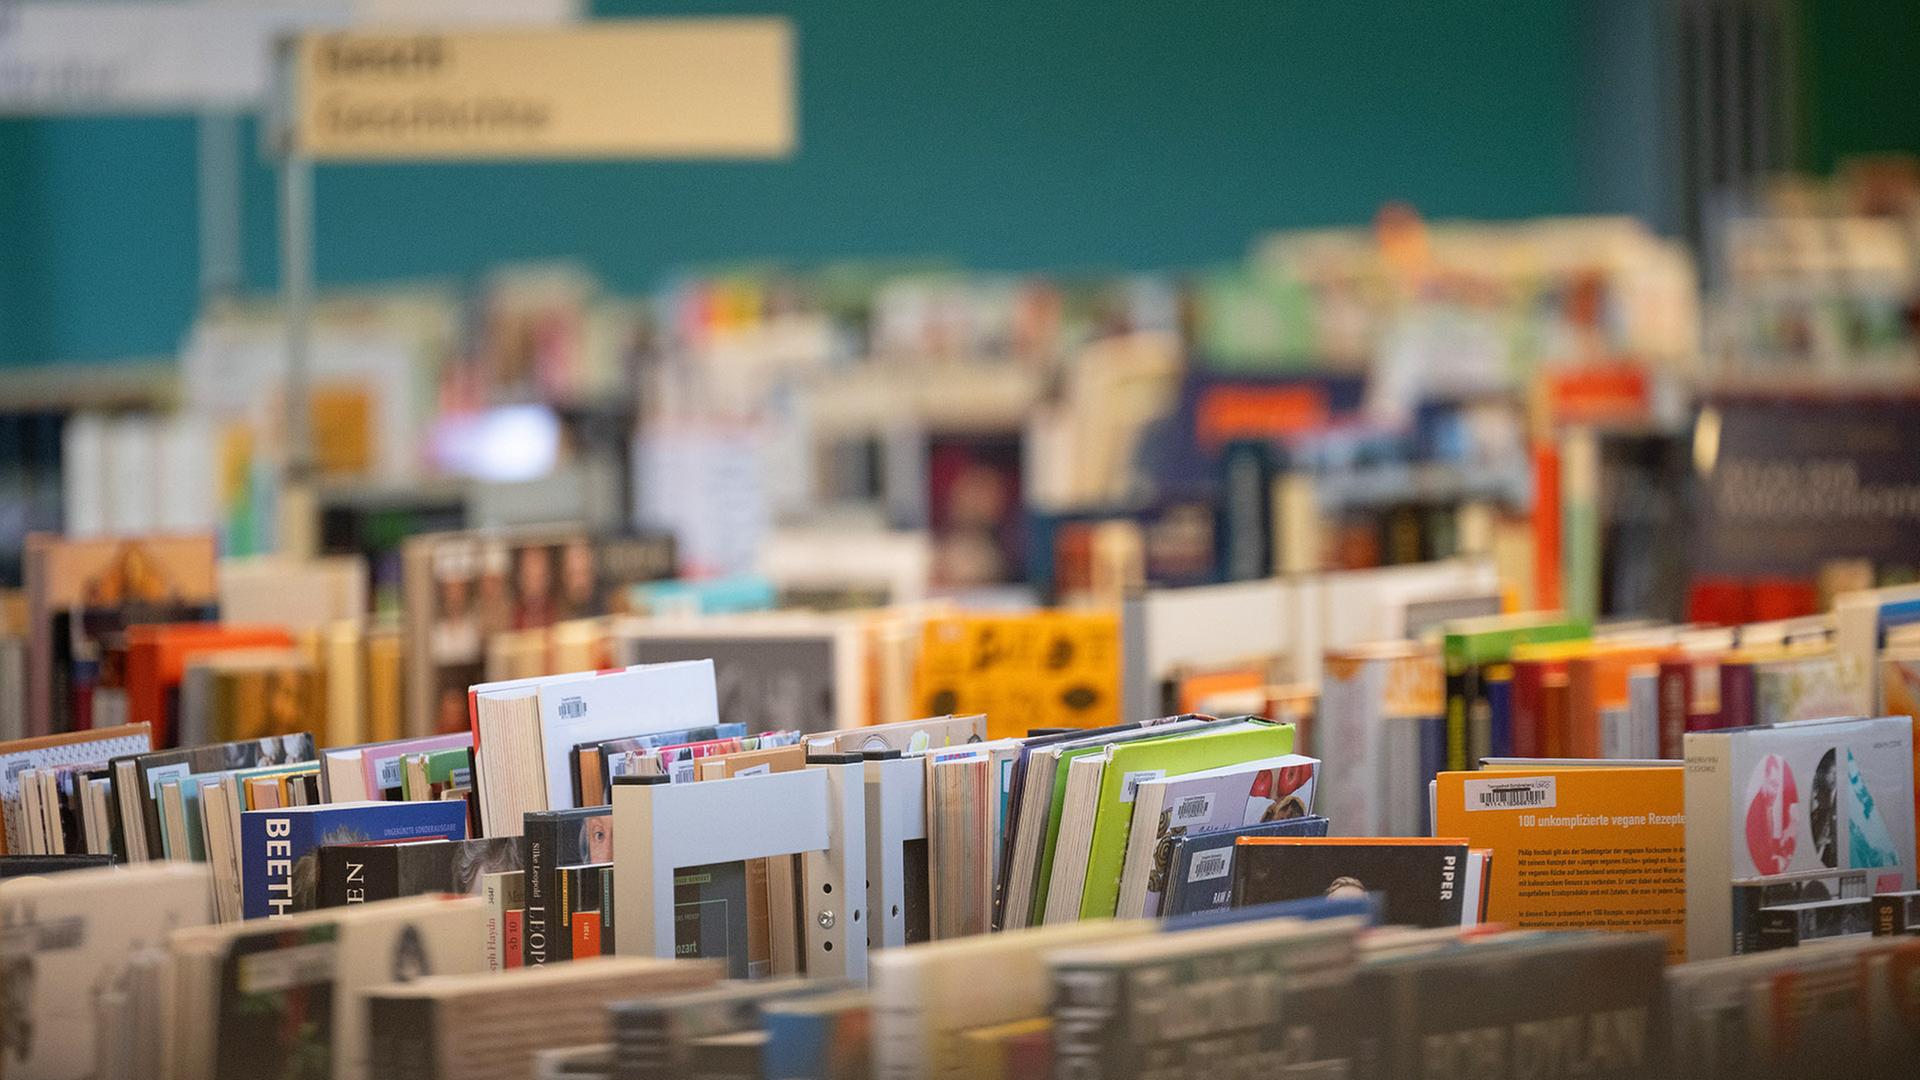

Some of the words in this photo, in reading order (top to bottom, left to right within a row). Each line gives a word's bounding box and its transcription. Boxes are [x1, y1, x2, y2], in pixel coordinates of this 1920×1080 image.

[1519, 815, 1535, 827] 100
[1538, 814, 1609, 829] unkomplizierte
[1612, 815, 1645, 828] vegane
[1648, 812, 1685, 826] Rezepte
[532, 842, 540, 863] Silke
[266, 818, 293, 920] BEETH
[531, 865, 543, 898] Leopold
[1439, 855, 1457, 901] PIPER
[487, 918, 497, 950] Haydn
